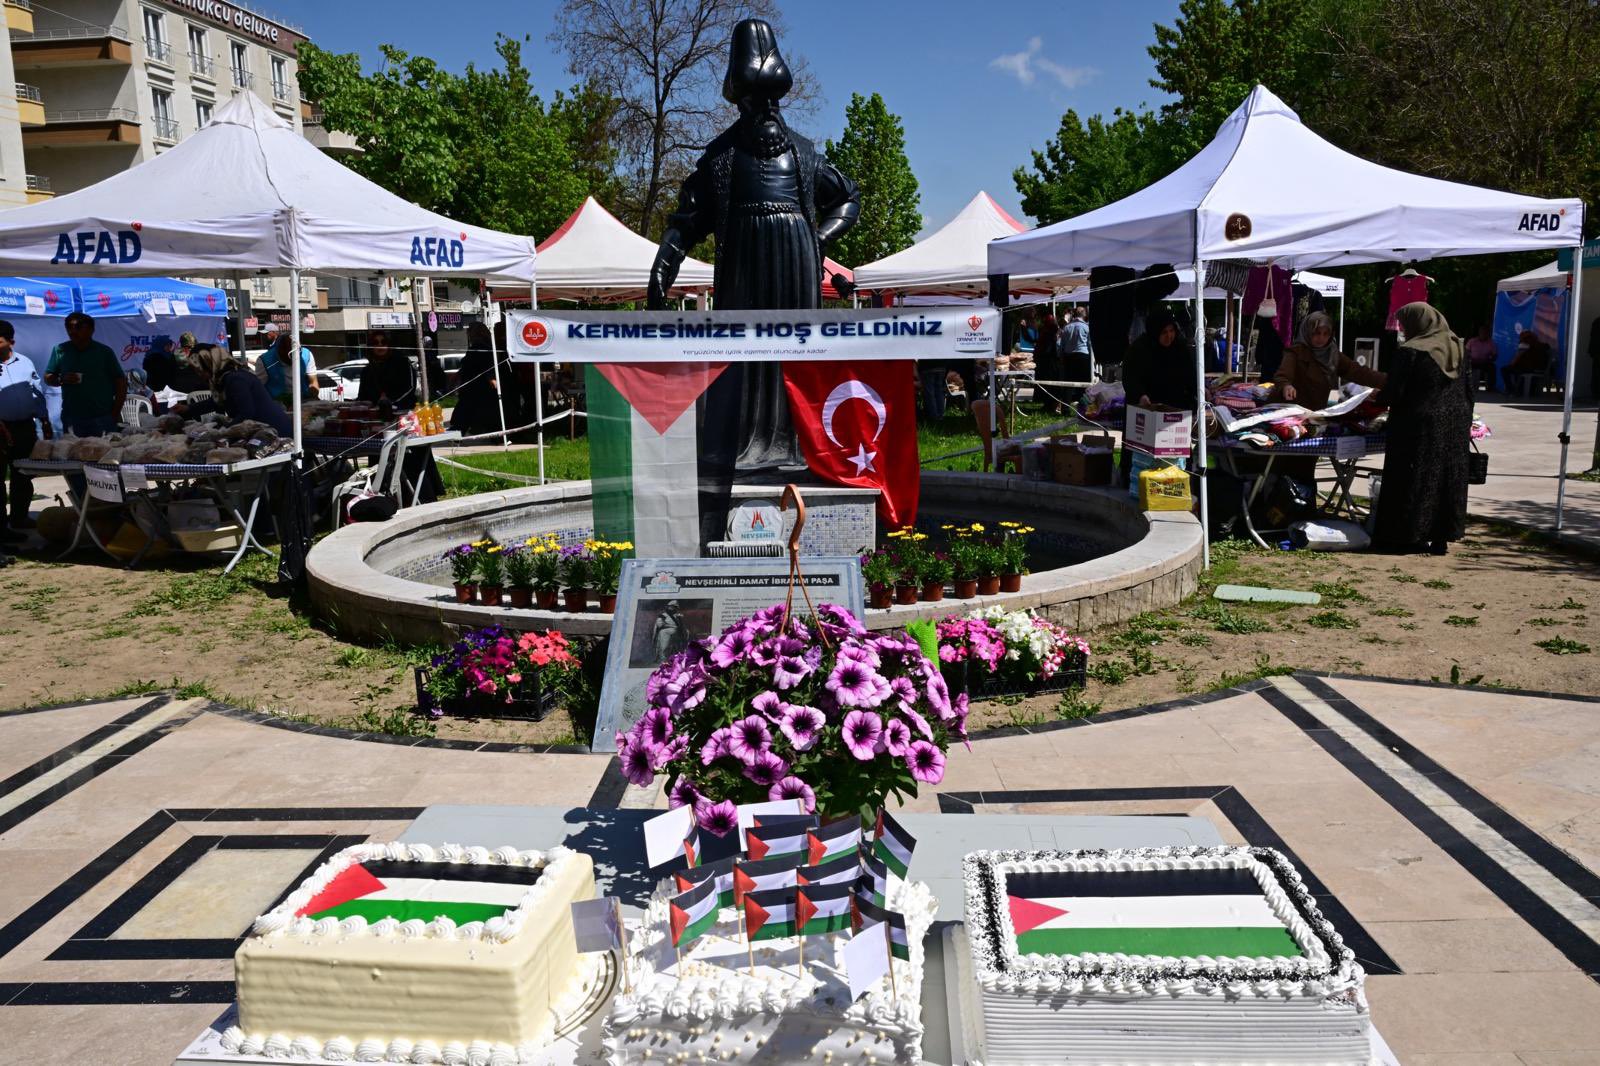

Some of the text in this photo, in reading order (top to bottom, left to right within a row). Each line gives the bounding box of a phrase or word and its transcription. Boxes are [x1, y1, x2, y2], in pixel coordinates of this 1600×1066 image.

[234, 10, 278, 42] deluxe
[1518, 213, 1561, 231] AFAD
[50, 230, 142, 265] AFAD
[410, 236, 464, 267] AFAD
[567, 315, 943, 344] KERMESİMİZE HOŞ GELDİNİZ
[684, 577, 737, 586] NEVŞEHİRLİ
[811, 577, 834, 585] PAŞA
